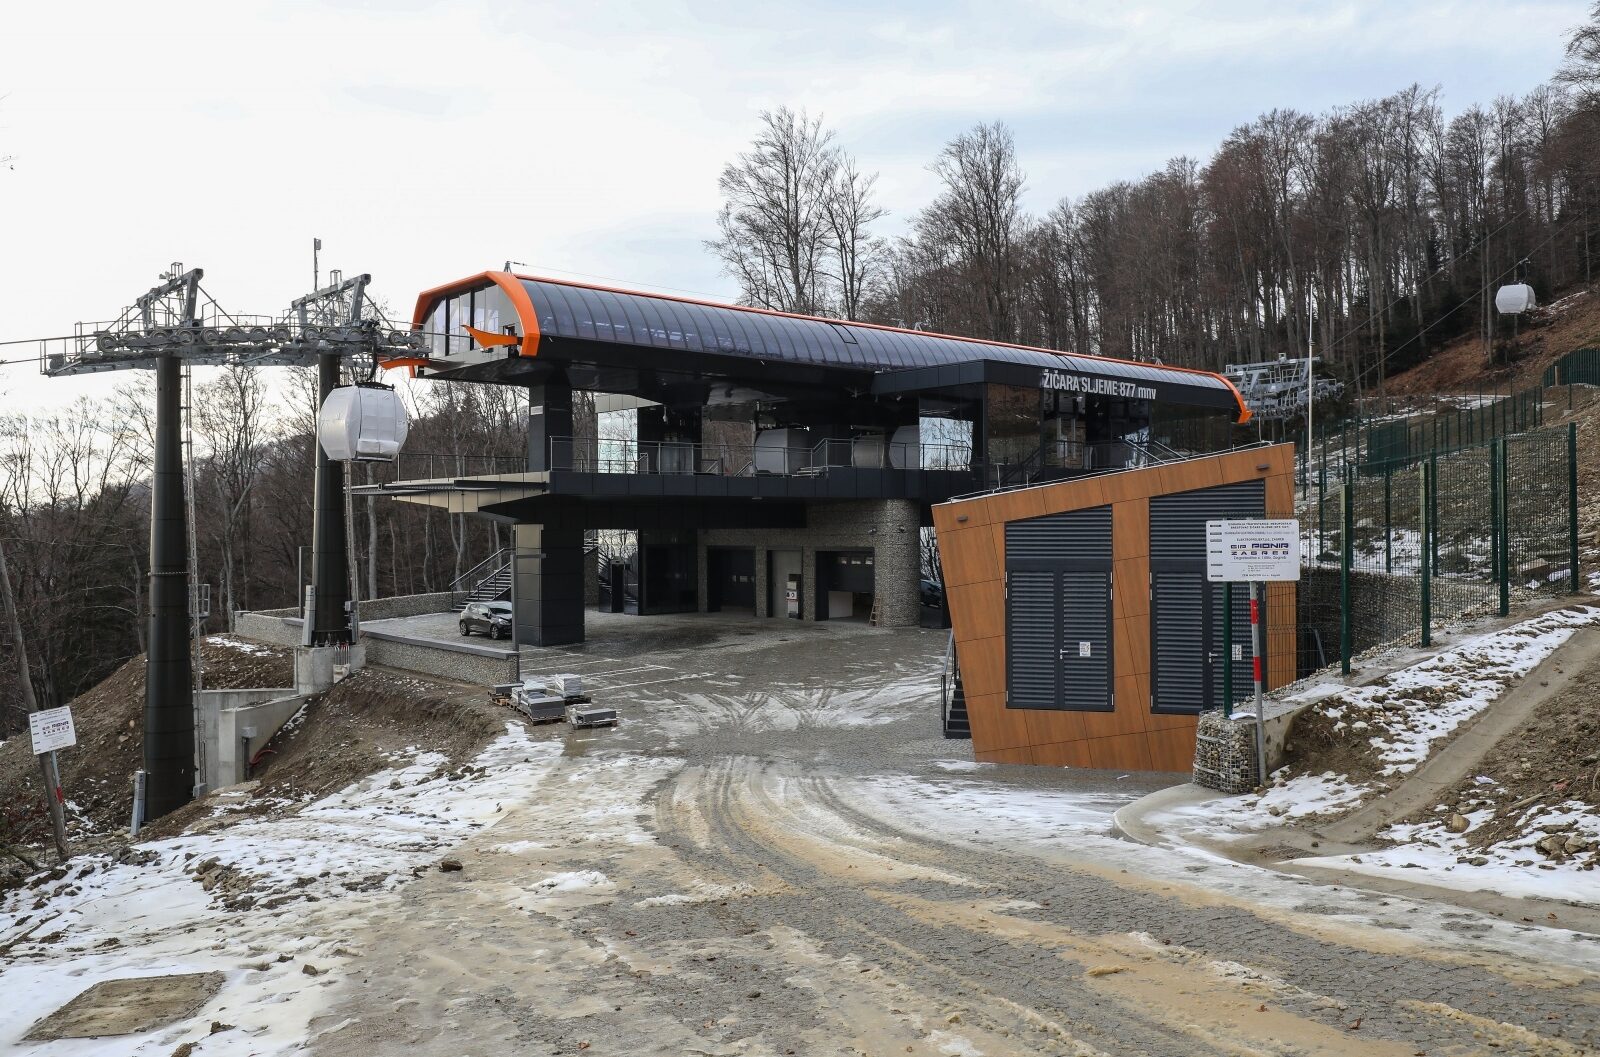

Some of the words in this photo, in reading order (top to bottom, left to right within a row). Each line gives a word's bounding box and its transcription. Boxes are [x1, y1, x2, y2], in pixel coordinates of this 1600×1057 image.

[1043, 369, 1080, 392] ŽIČARA
[1081, 377, 1118, 396] SLJEME
[1119, 381, 1136, 397] 877
[1138, 386, 1157, 400] mnv
